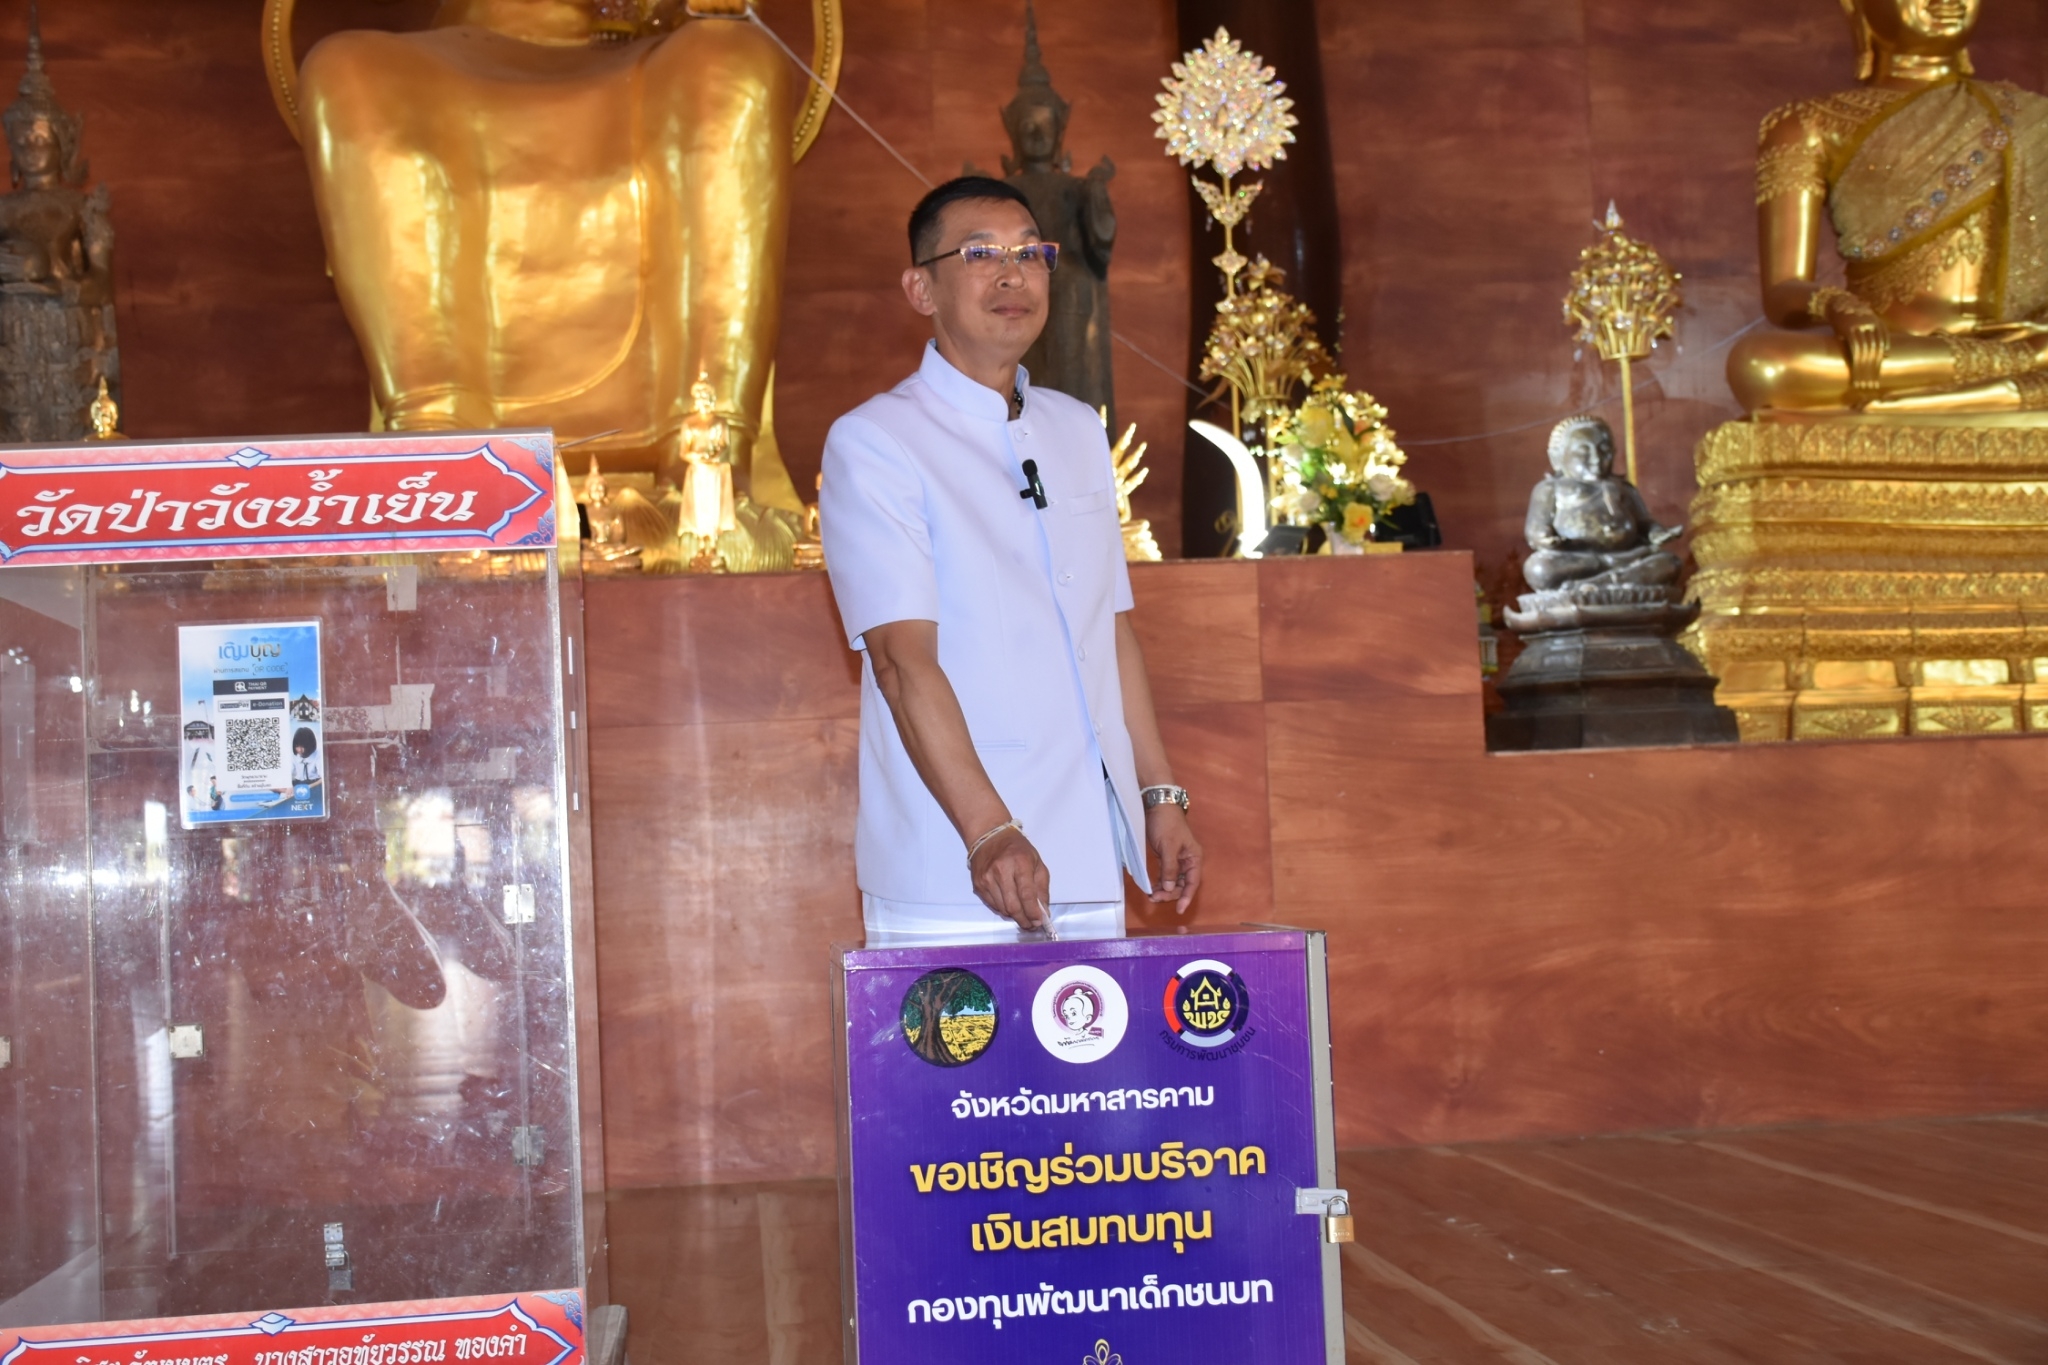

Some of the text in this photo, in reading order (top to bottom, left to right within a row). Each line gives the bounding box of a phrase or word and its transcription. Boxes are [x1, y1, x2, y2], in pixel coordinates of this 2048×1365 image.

[16, 468, 479, 537] วัดป่าวังน้ำเย็น
[218, 641, 282, 662] เติมบุญ
[291, 803, 314, 812] NEXT
[1160, 1026, 1257, 1061] กรมการพัฒนาชุมชน
[950, 1083, 1215, 1119] จังหวัดมหาสารคาม
[909, 1141, 1267, 1195] ขอเชิญร่วมบริจาค
[971, 1208, 1214, 1254] เงินสมทบทุน
[907, 1274, 1274, 1330] กองทุนพัฒนาเด็กชนบท
[454, 1324, 527, 1361] ทองคำ
